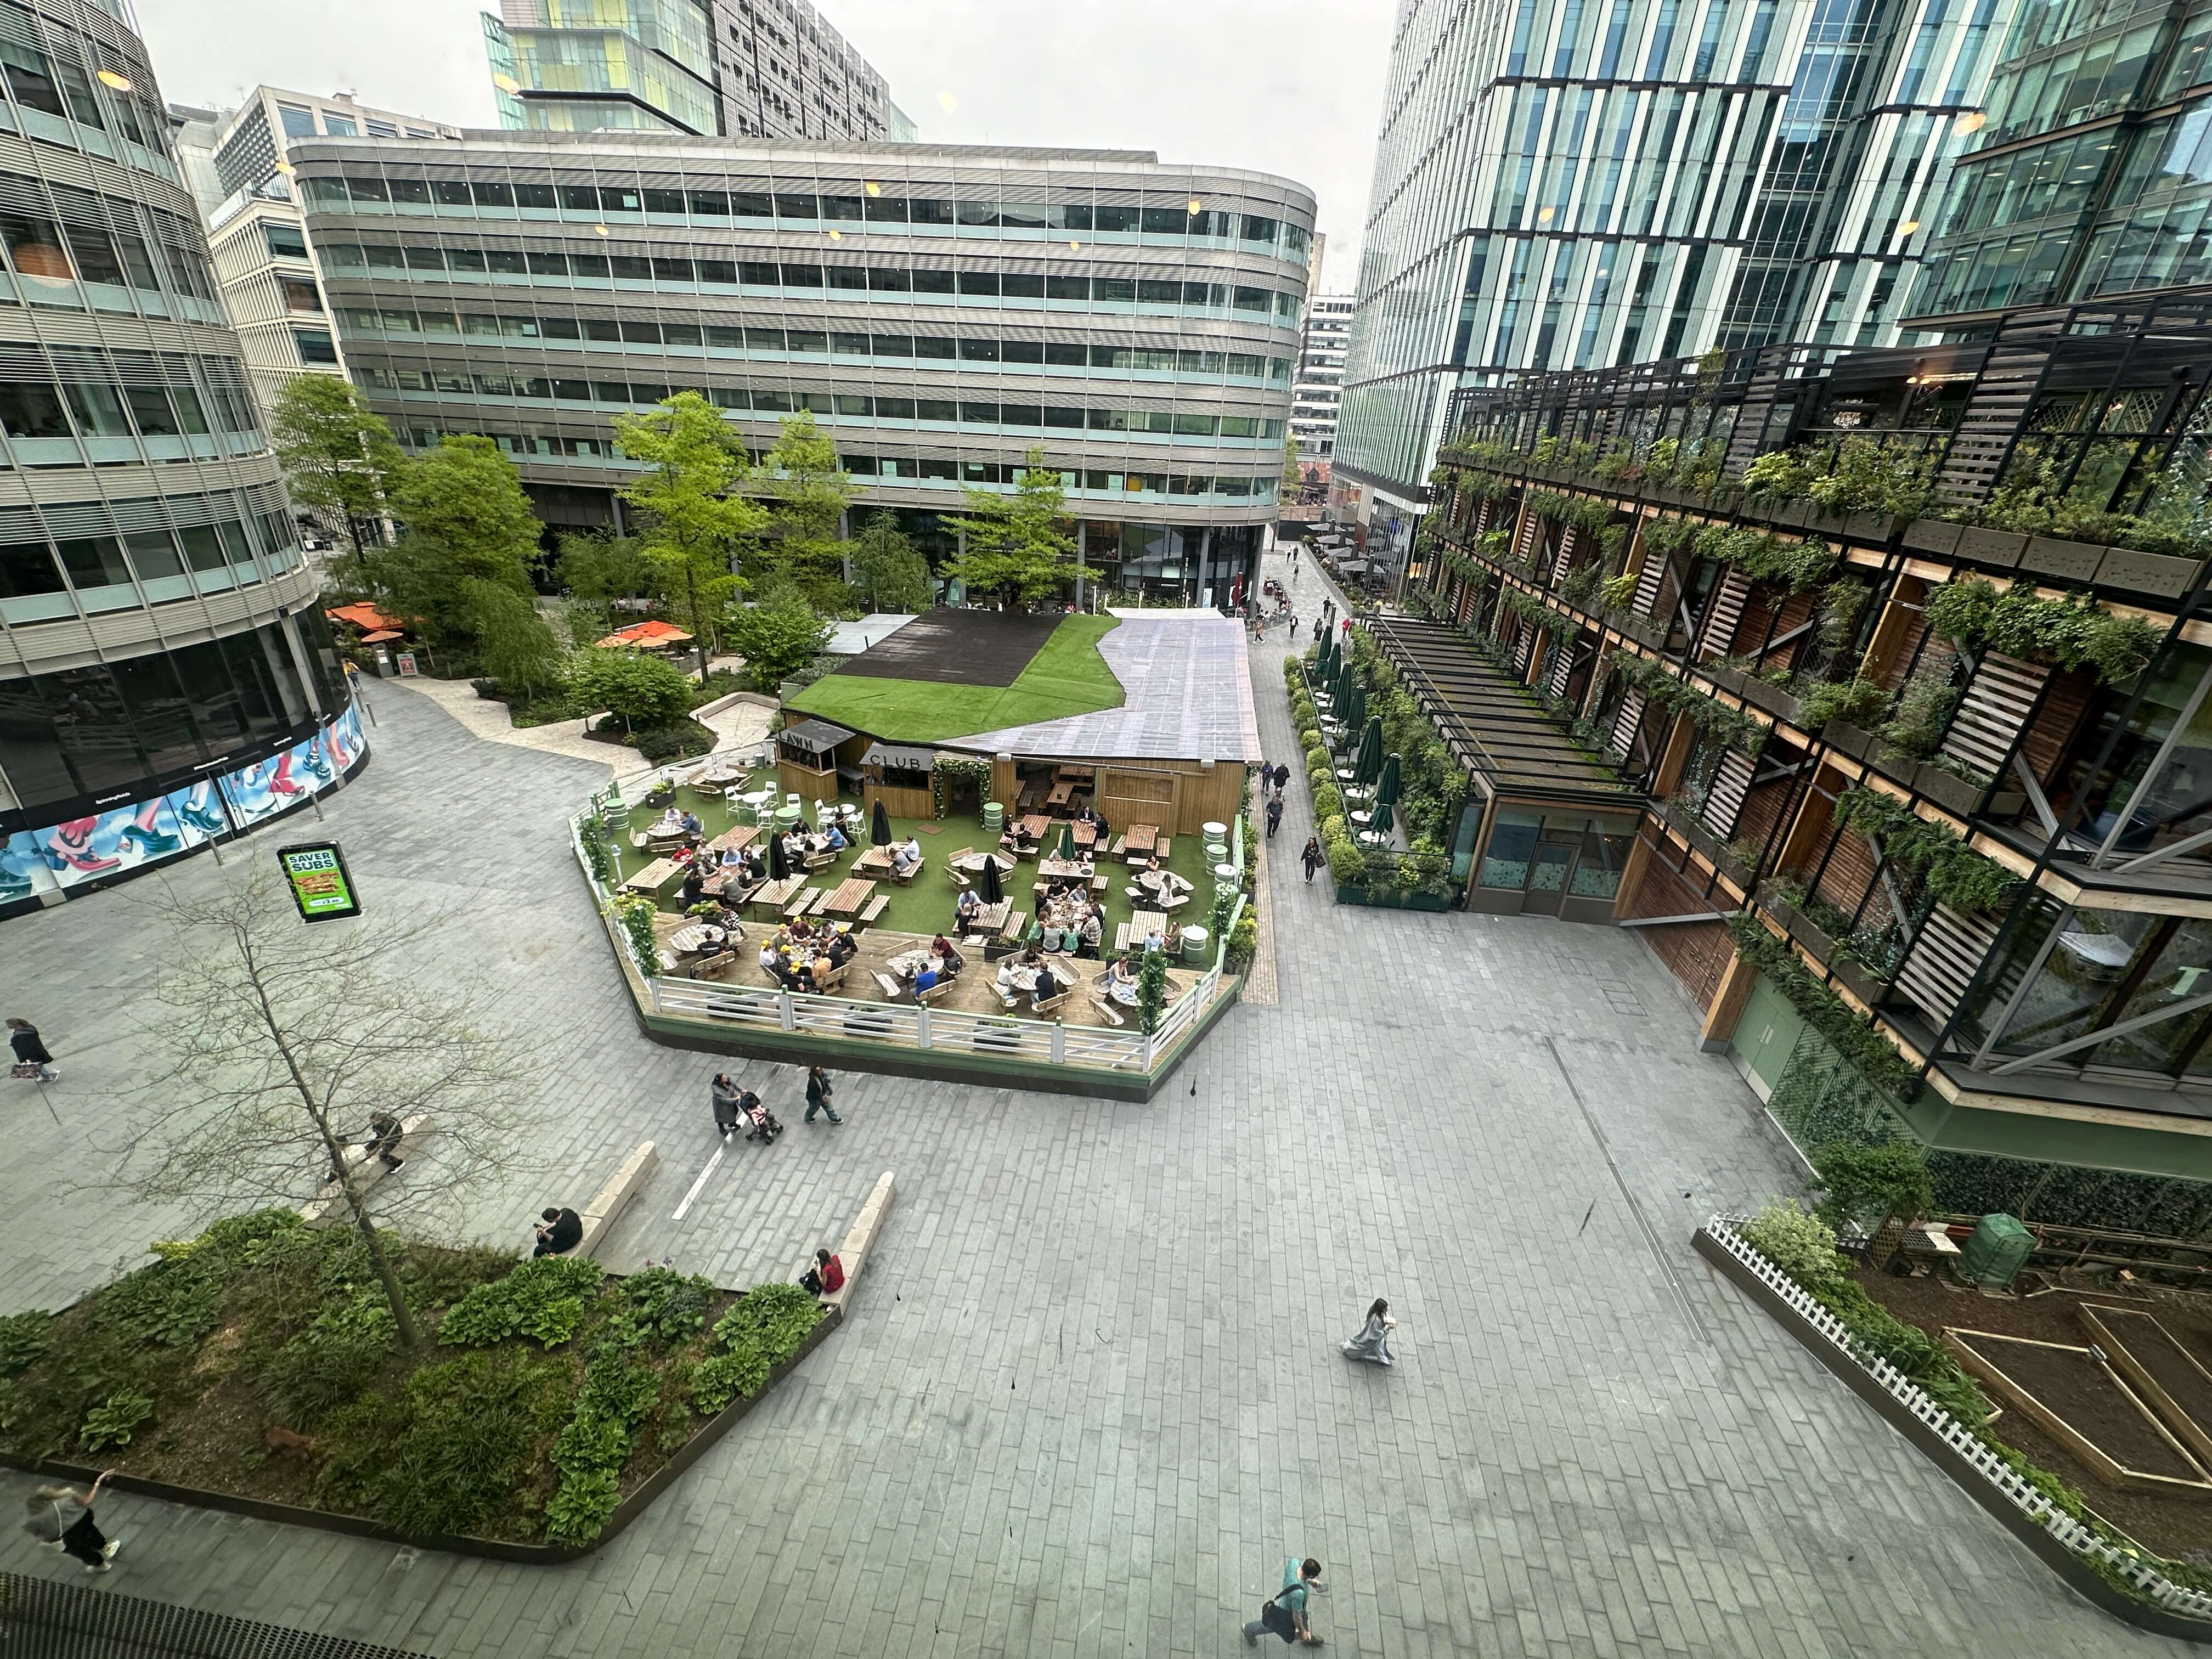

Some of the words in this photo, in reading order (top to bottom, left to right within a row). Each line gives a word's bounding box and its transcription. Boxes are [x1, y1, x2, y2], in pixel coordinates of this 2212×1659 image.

[778, 730, 814, 751] LAWN
[870, 755, 921, 769] CLUB
[289, 852, 331, 863] SAVER
[292, 859, 334, 872] SUBS
